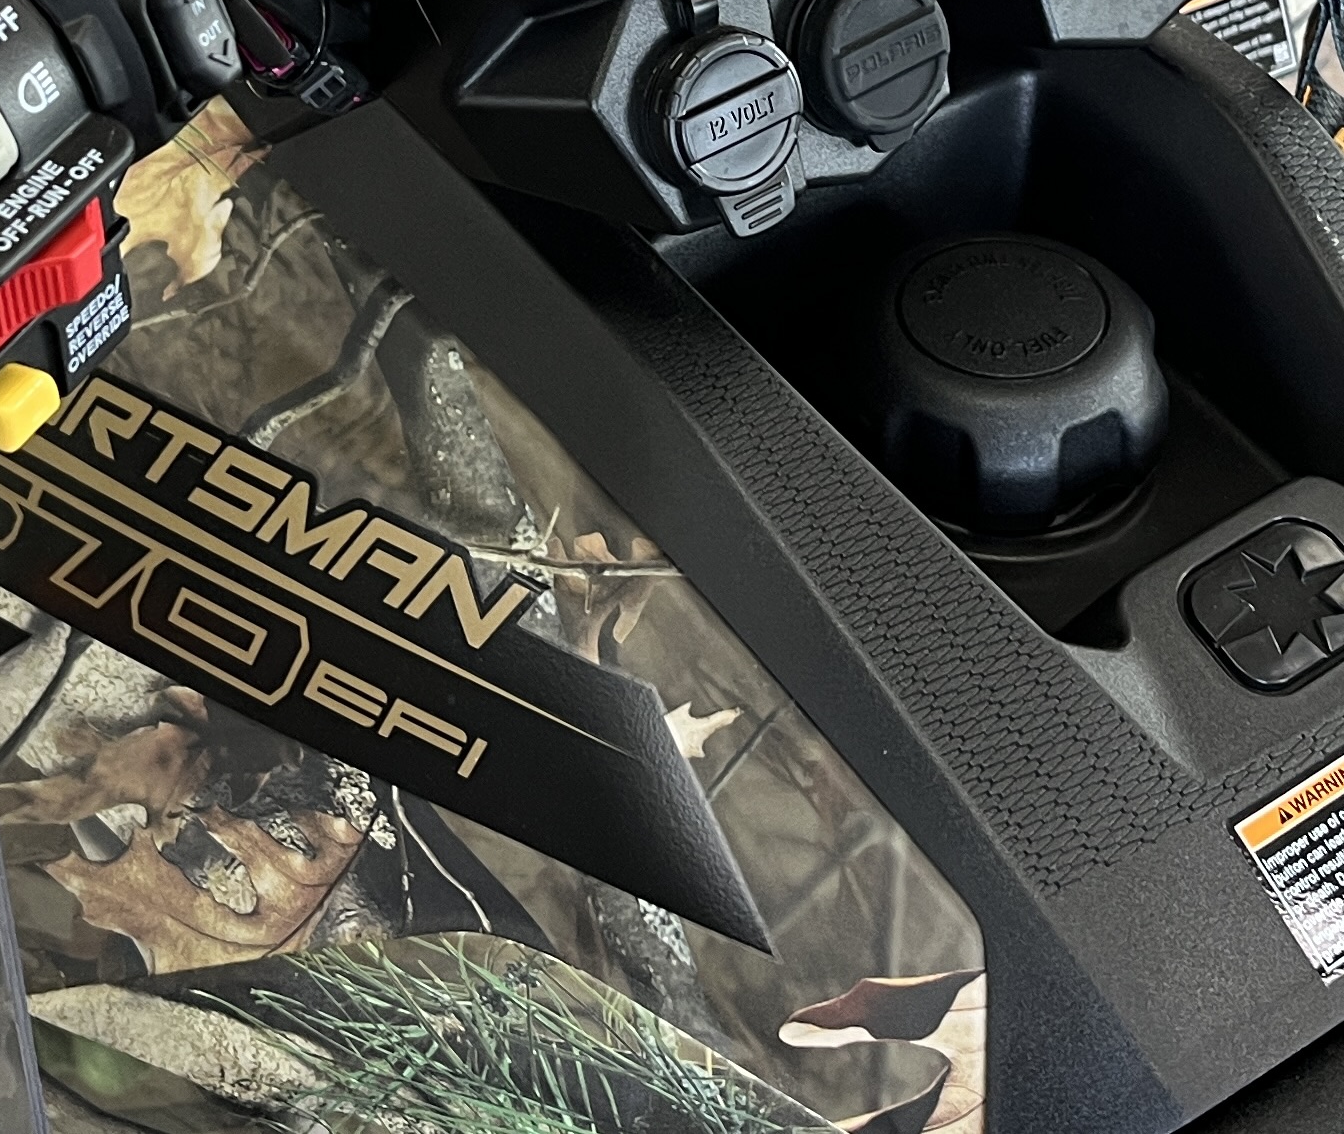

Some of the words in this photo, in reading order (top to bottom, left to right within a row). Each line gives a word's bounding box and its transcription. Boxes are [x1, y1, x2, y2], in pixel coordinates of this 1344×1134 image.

[197, 19, 223, 48] OUT
[845, 23, 942, 82] POLARIS
[708, 118, 726, 143] 12
[729, 91, 776, 137] VOLT
[65, 274, 122, 340] SPEEDO/
[67, 290, 127, 356] REVERSE
[67, 305, 131, 374] OVERRIDE
[48, 374, 536, 650] RTSMAN
[303, 658, 490, 778] EFI
